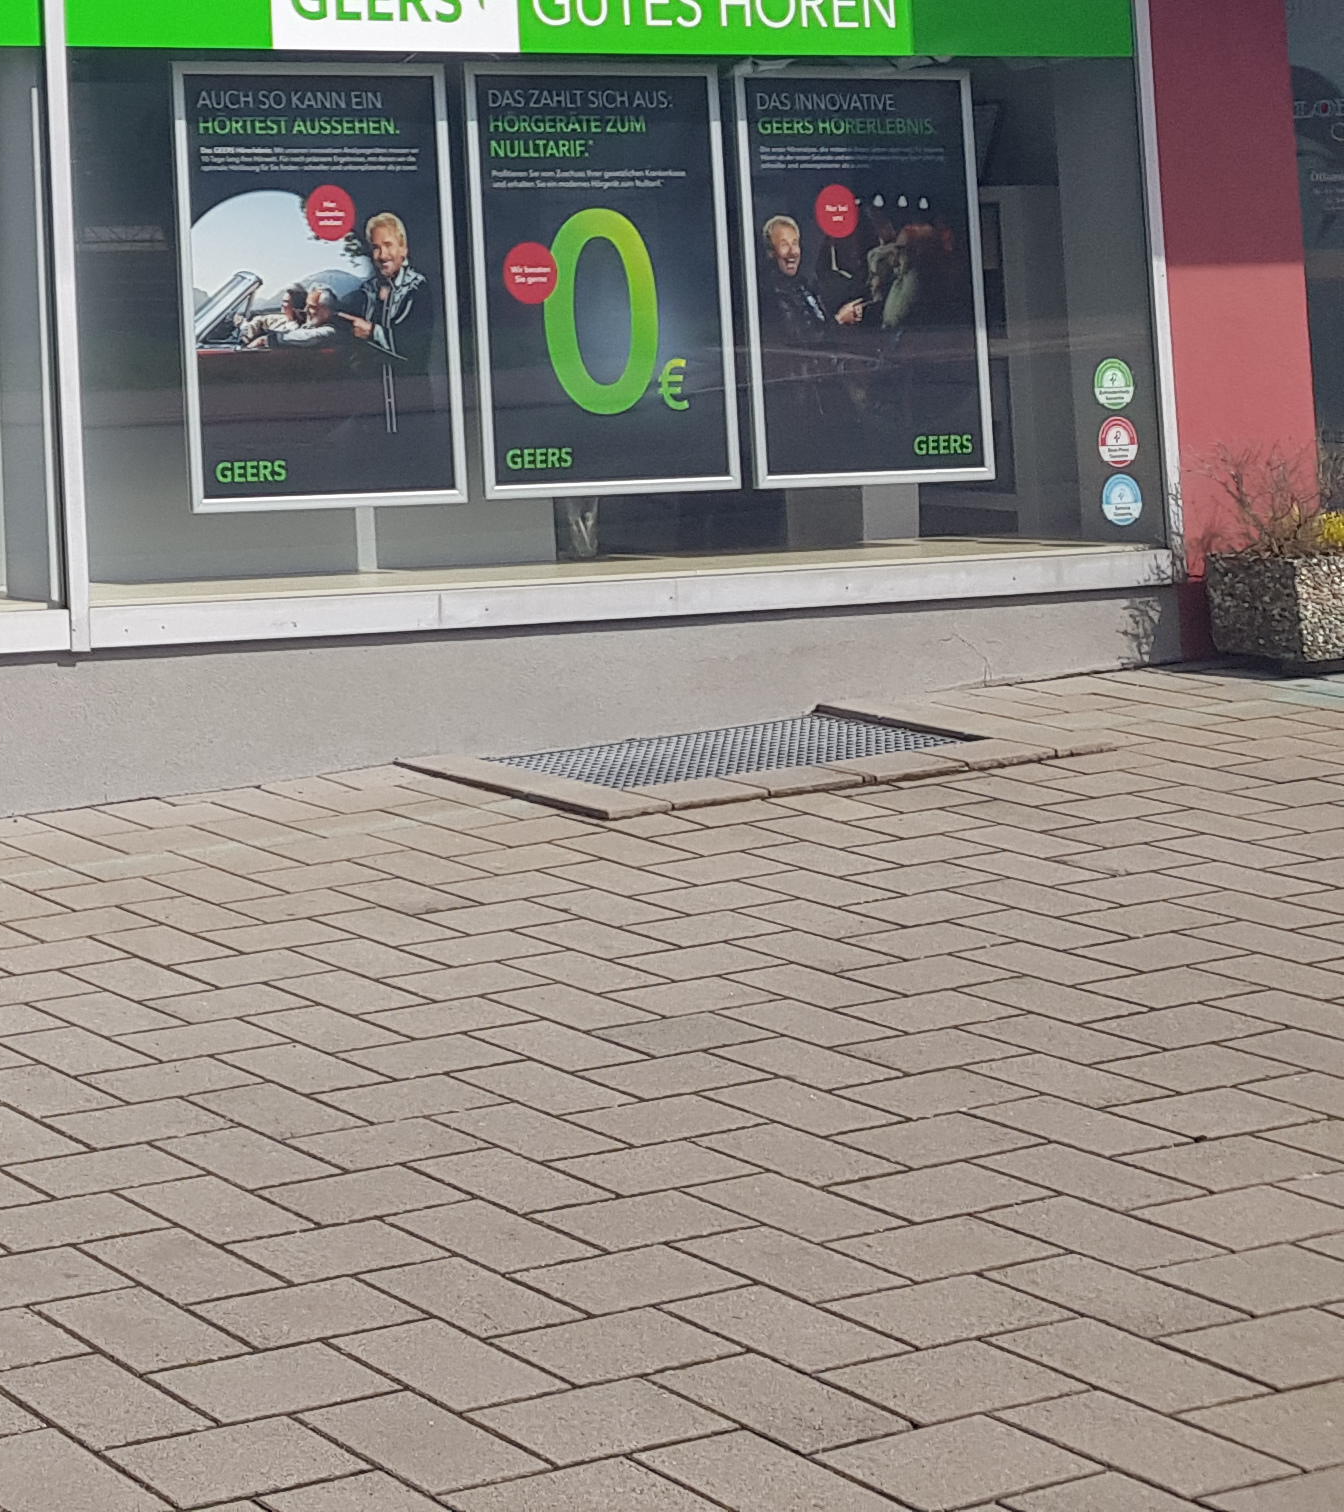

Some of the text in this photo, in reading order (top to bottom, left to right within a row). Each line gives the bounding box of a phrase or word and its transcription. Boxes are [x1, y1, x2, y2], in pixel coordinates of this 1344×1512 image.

[197, 91, 383, 109] AUCH SO KANN EIN
[488, 90, 673, 109] DAS ZAHLT SICH AUS:
[756, 93, 896, 111] DAS INNOVATIVE
[199, 112, 400, 135] HÖRTEST AUSSEHEN.
[489, 111, 646, 133] HÖRGERÄTE ZUM
[757, 117, 814, 135] GEERS
[912, 434, 973, 456] GEERS
[506, 447, 573, 471] GEERS
[215, 459, 288, 484] GEERS
